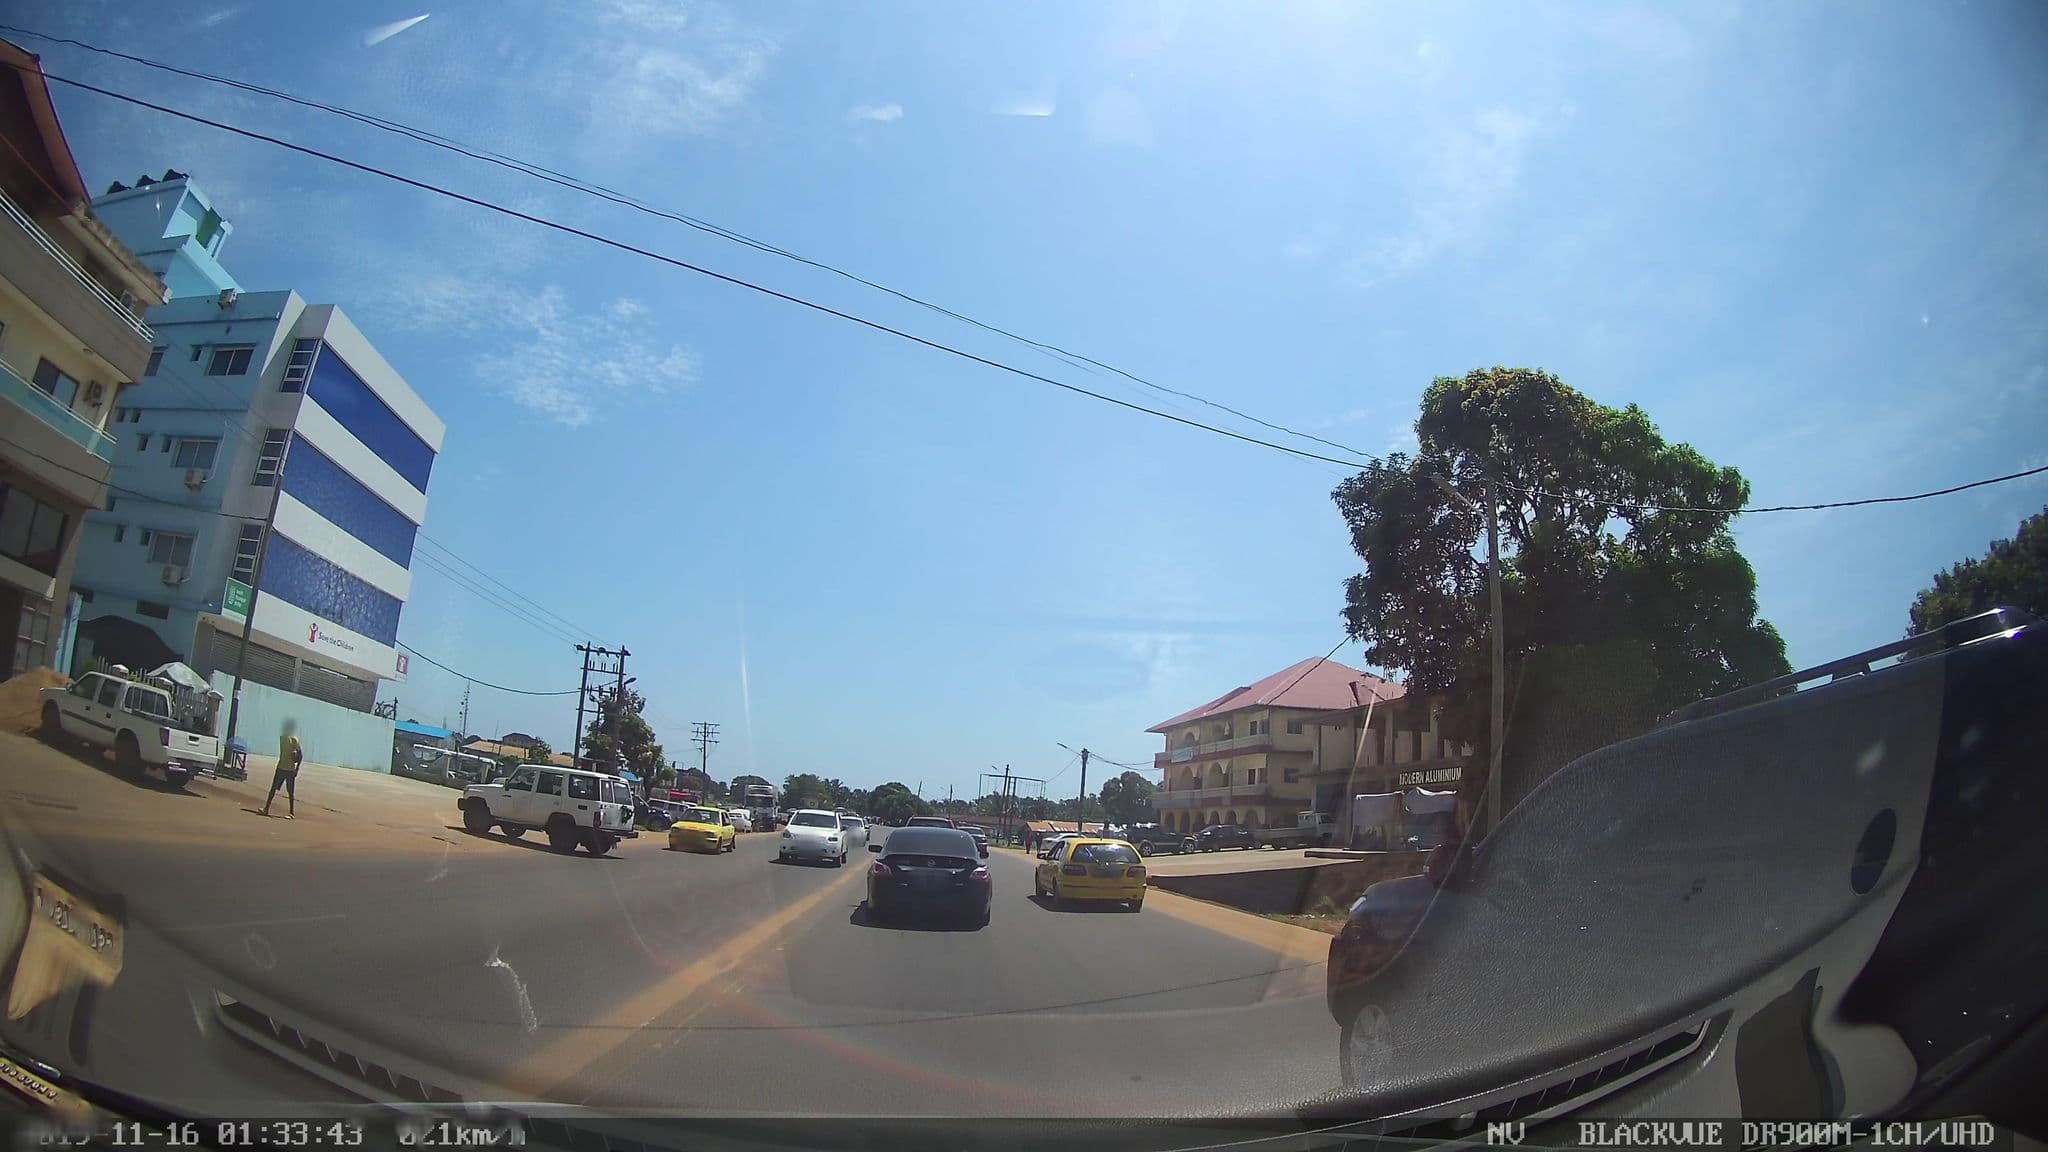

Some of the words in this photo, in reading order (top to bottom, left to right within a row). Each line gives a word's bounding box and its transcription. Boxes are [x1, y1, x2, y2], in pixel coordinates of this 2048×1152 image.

[319, 632, 329, 643] Save
[337, 640, 354, 652] Children
[1425, 767, 1462, 783] ALUMINIUM
